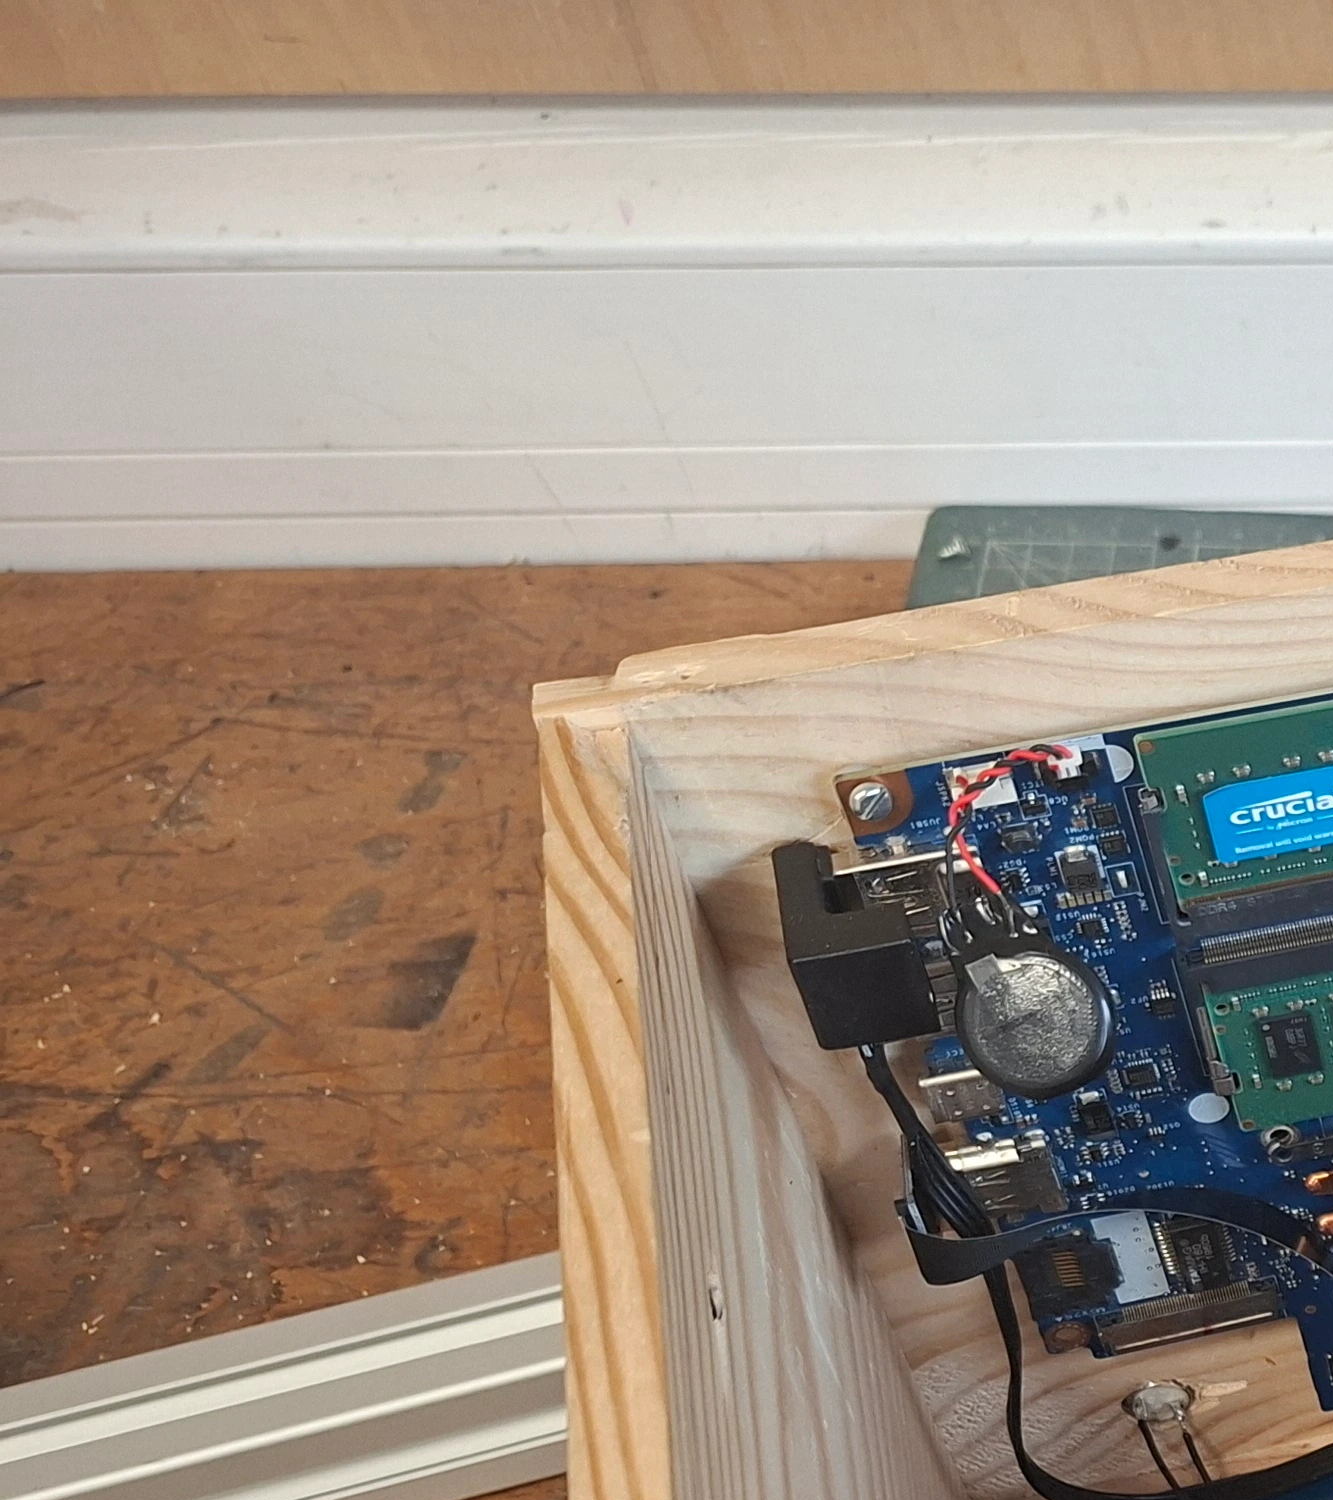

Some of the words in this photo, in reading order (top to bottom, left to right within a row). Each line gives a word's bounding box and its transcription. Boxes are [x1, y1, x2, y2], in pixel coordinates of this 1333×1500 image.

[1234, 840, 1274, 855] Removal
[1275, 837, 1292, 848] will
[1293, 833, 1313, 844] void
